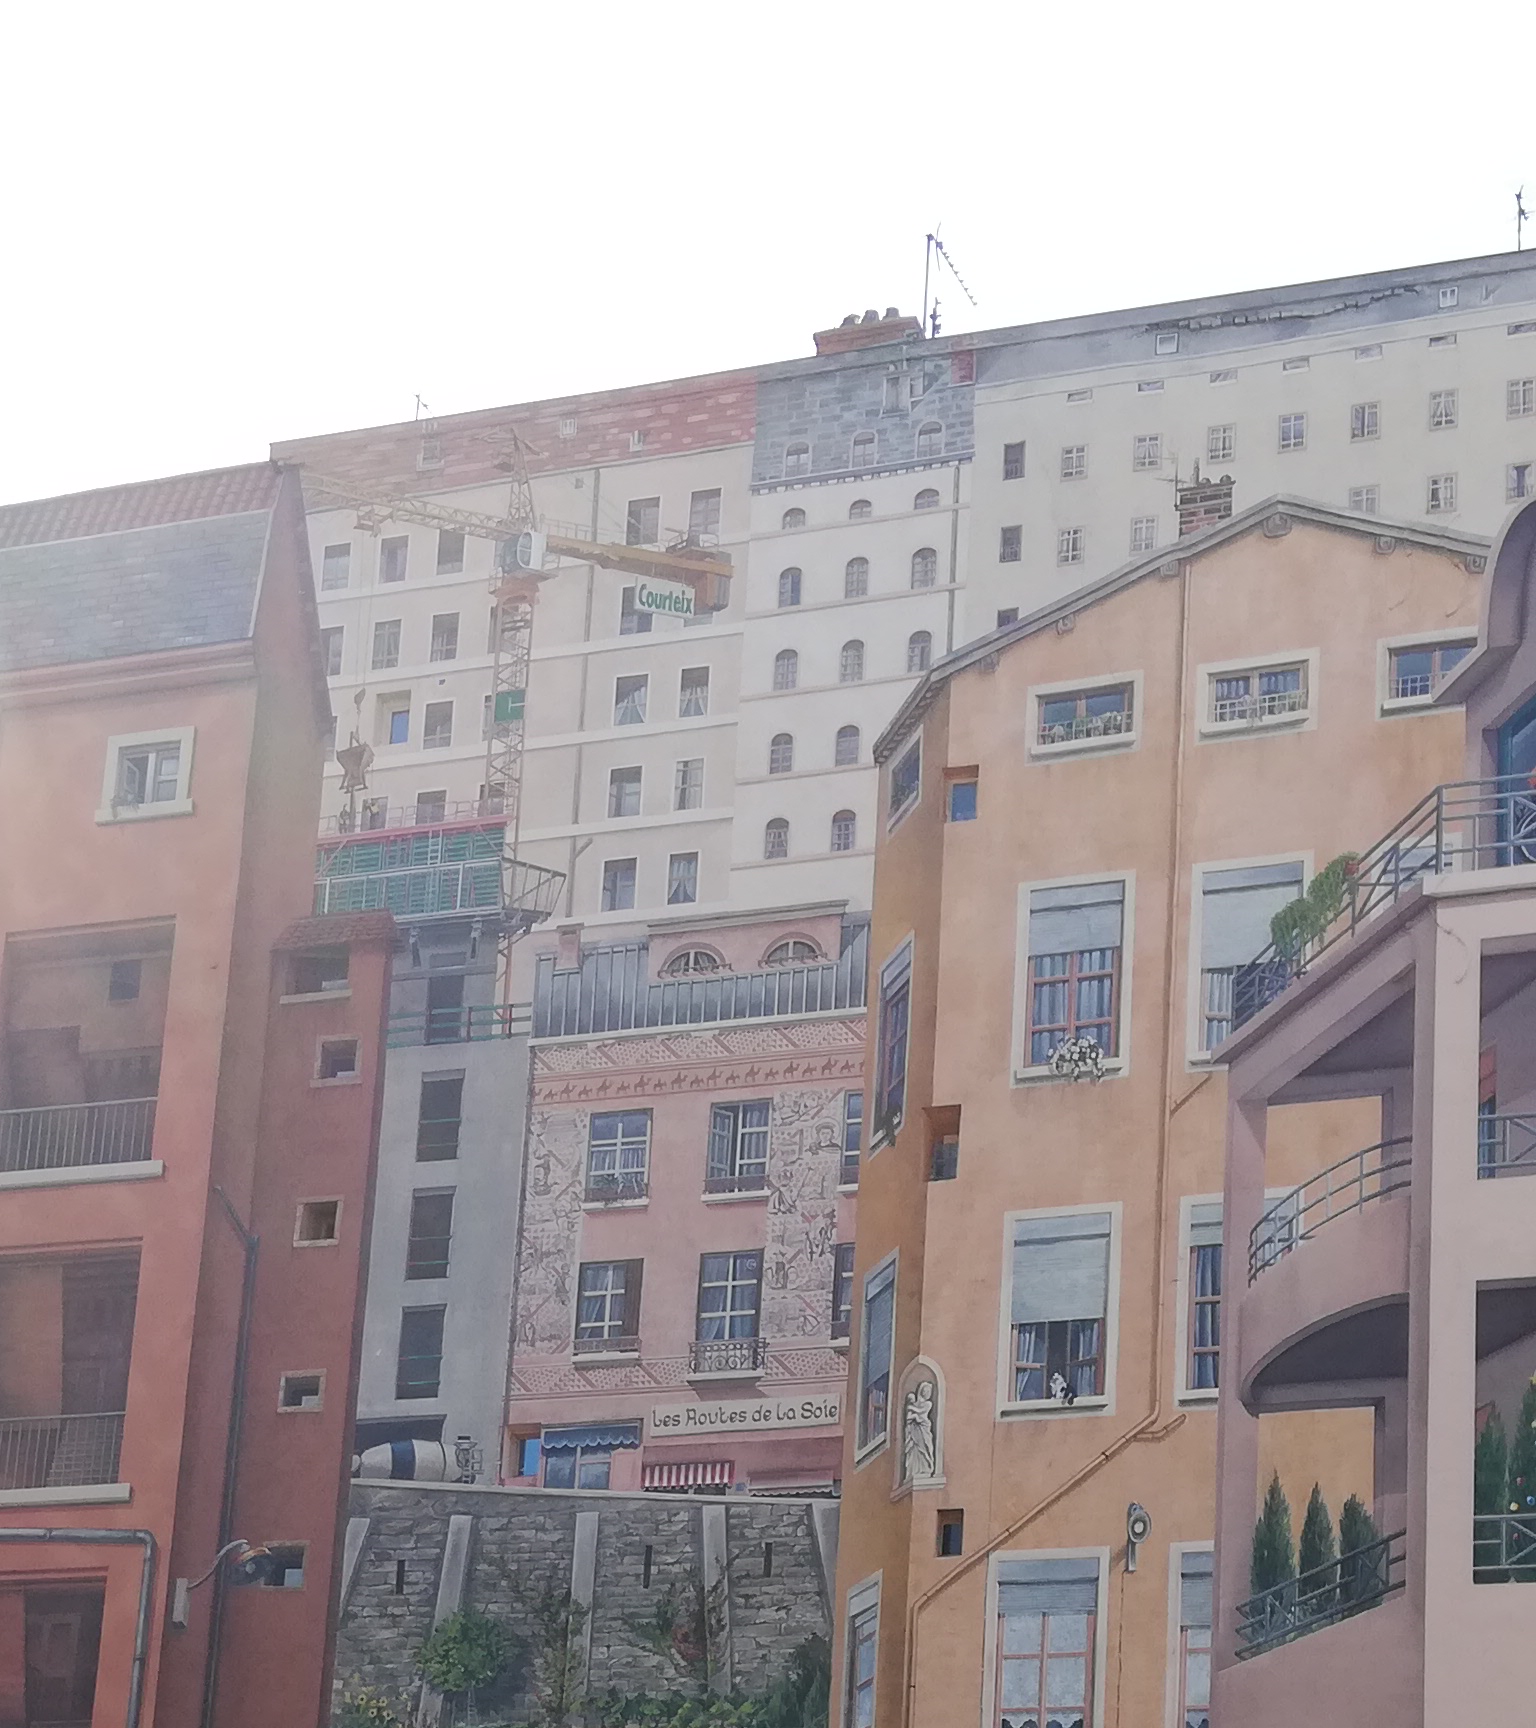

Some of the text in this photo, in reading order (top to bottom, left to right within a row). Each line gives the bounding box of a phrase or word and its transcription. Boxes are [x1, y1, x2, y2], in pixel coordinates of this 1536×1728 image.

[652, 1408, 681, 1428] Les
[685, 1405, 748, 1427] Routes
[751, 1404, 772, 1423] de
[800, 1399, 839, 1420] Soie
